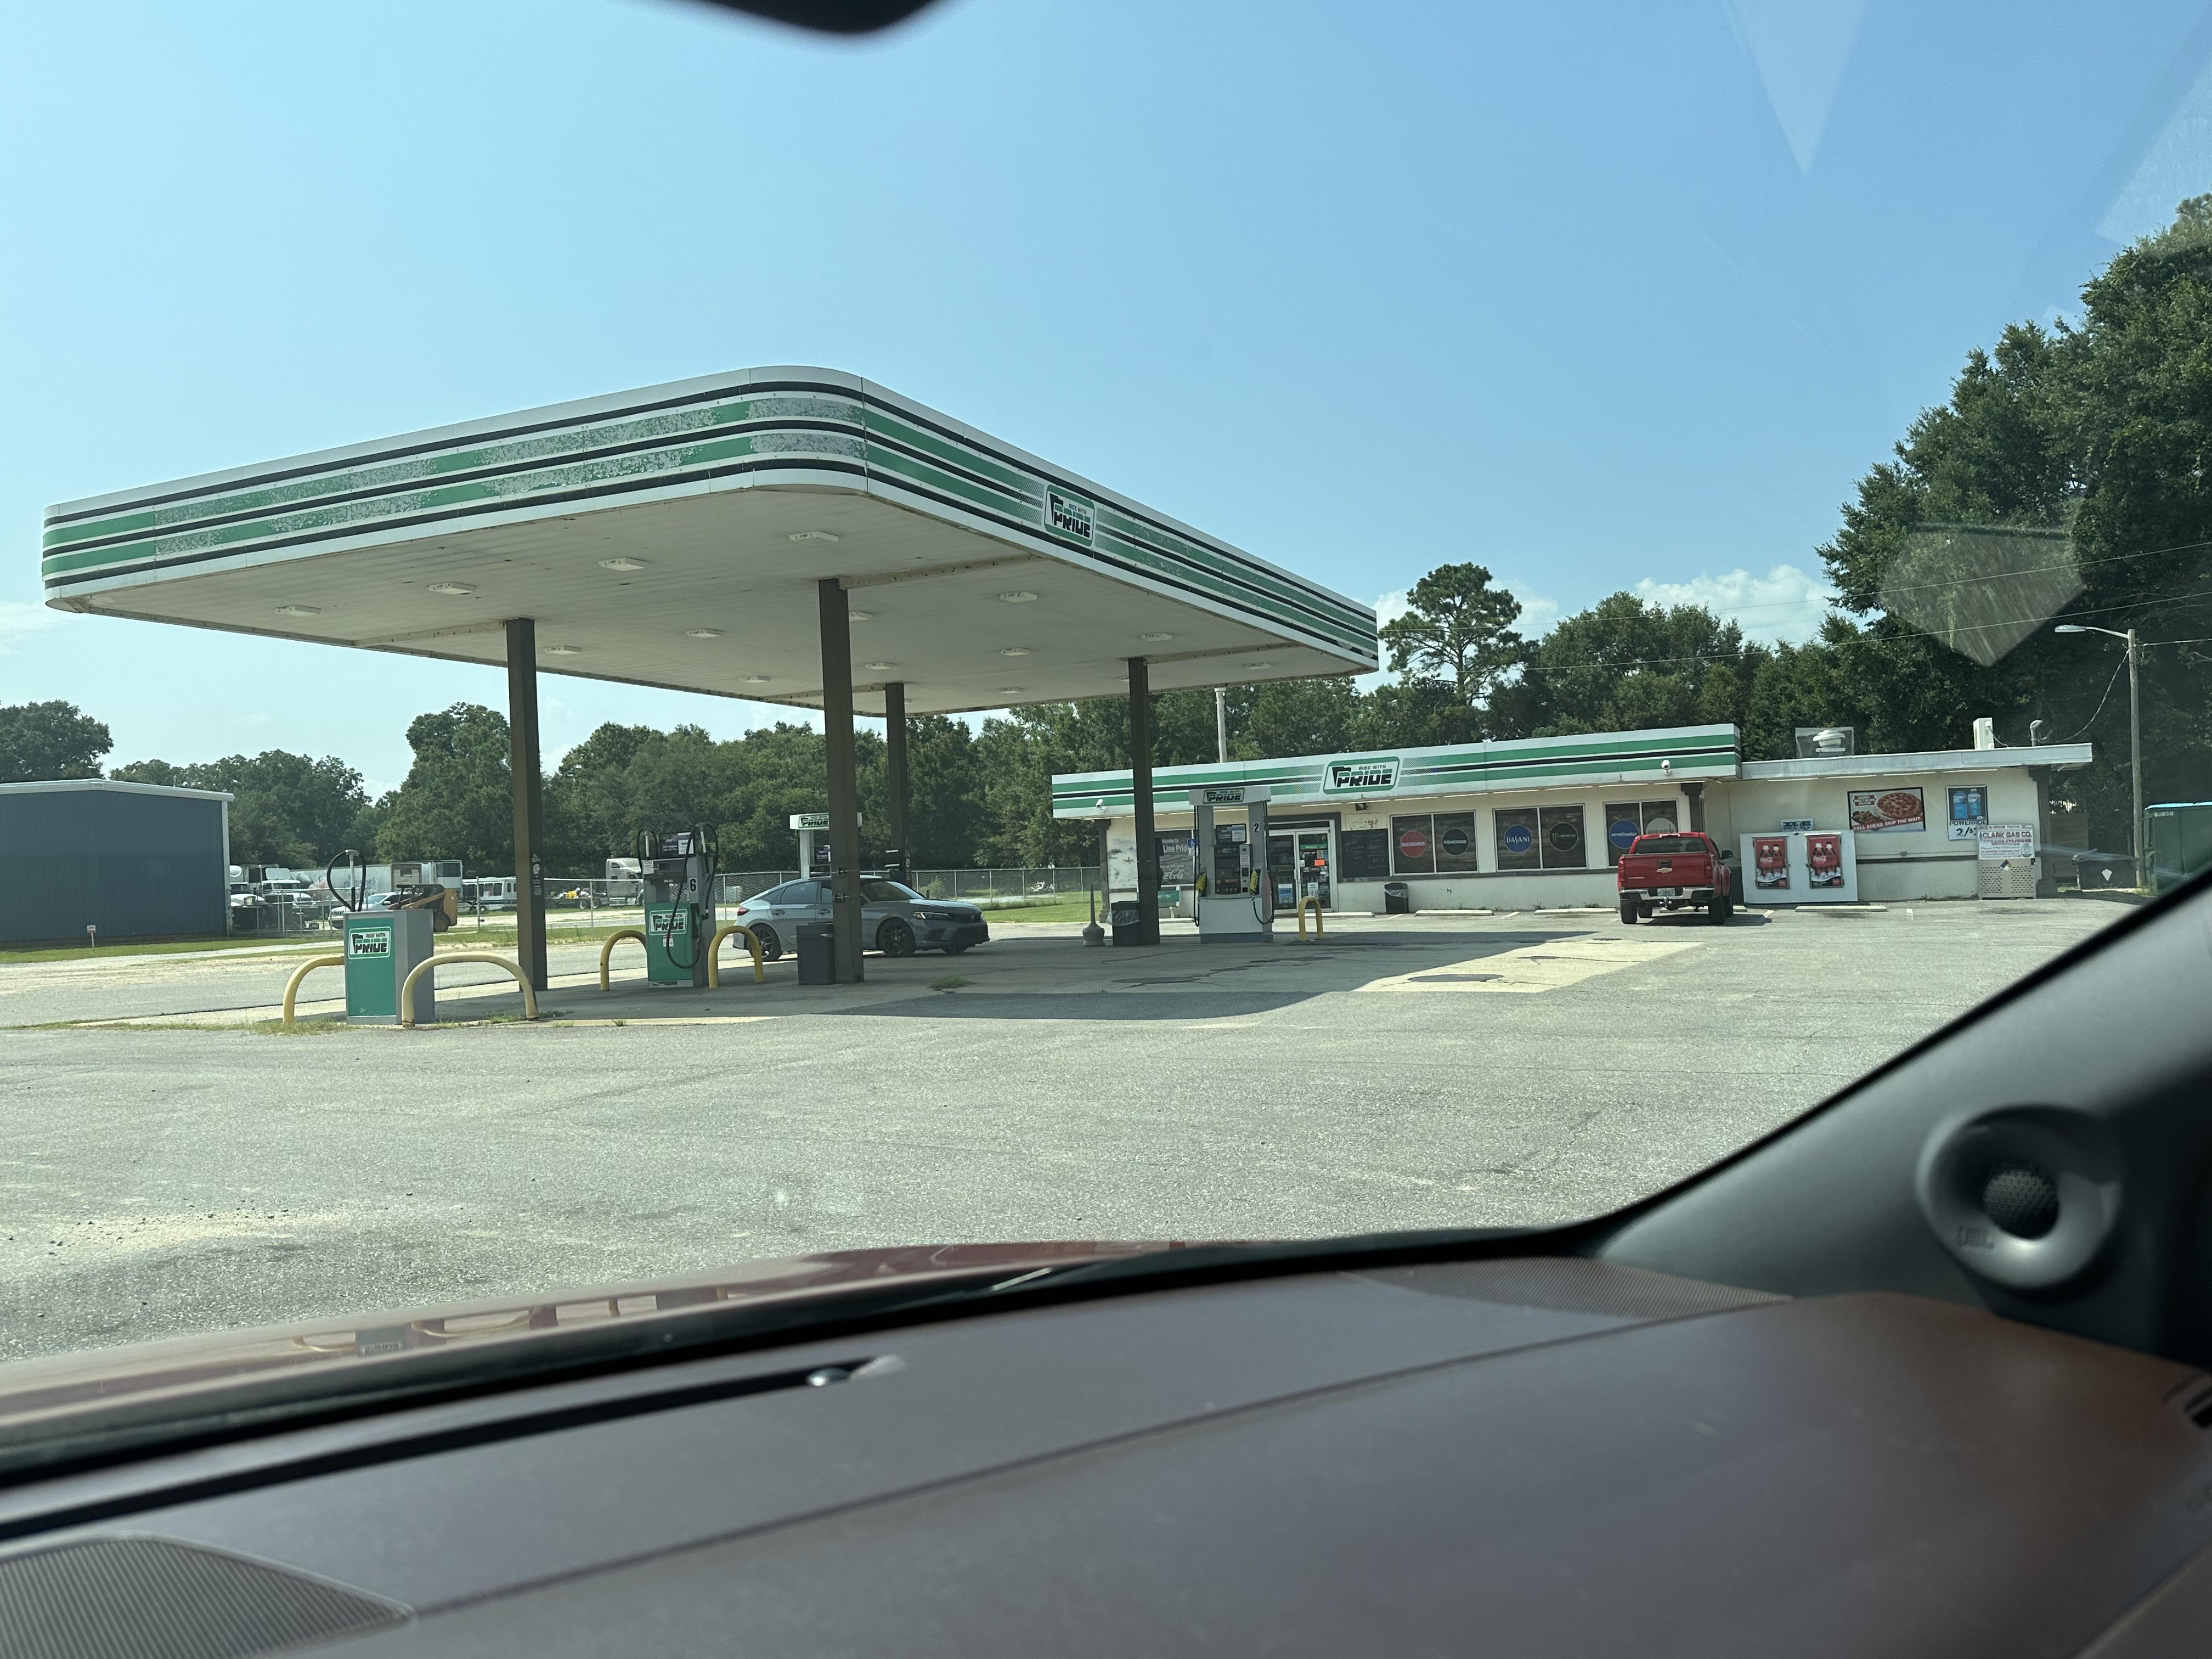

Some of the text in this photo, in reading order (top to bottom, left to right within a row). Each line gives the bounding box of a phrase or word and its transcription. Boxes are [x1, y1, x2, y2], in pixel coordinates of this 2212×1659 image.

[1053, 503, 1091, 538] PRIDE
[1336, 769, 1393, 788] PRIDE
[1209, 793, 1242, 802] PRIDE
[1254, 823, 1260, 833] 2
[1506, 836, 1530, 844] DASANI
[690, 878, 696, 891] 6
[655, 918, 684, 930] PRDE
[354, 938, 387, 953] PRIDE
